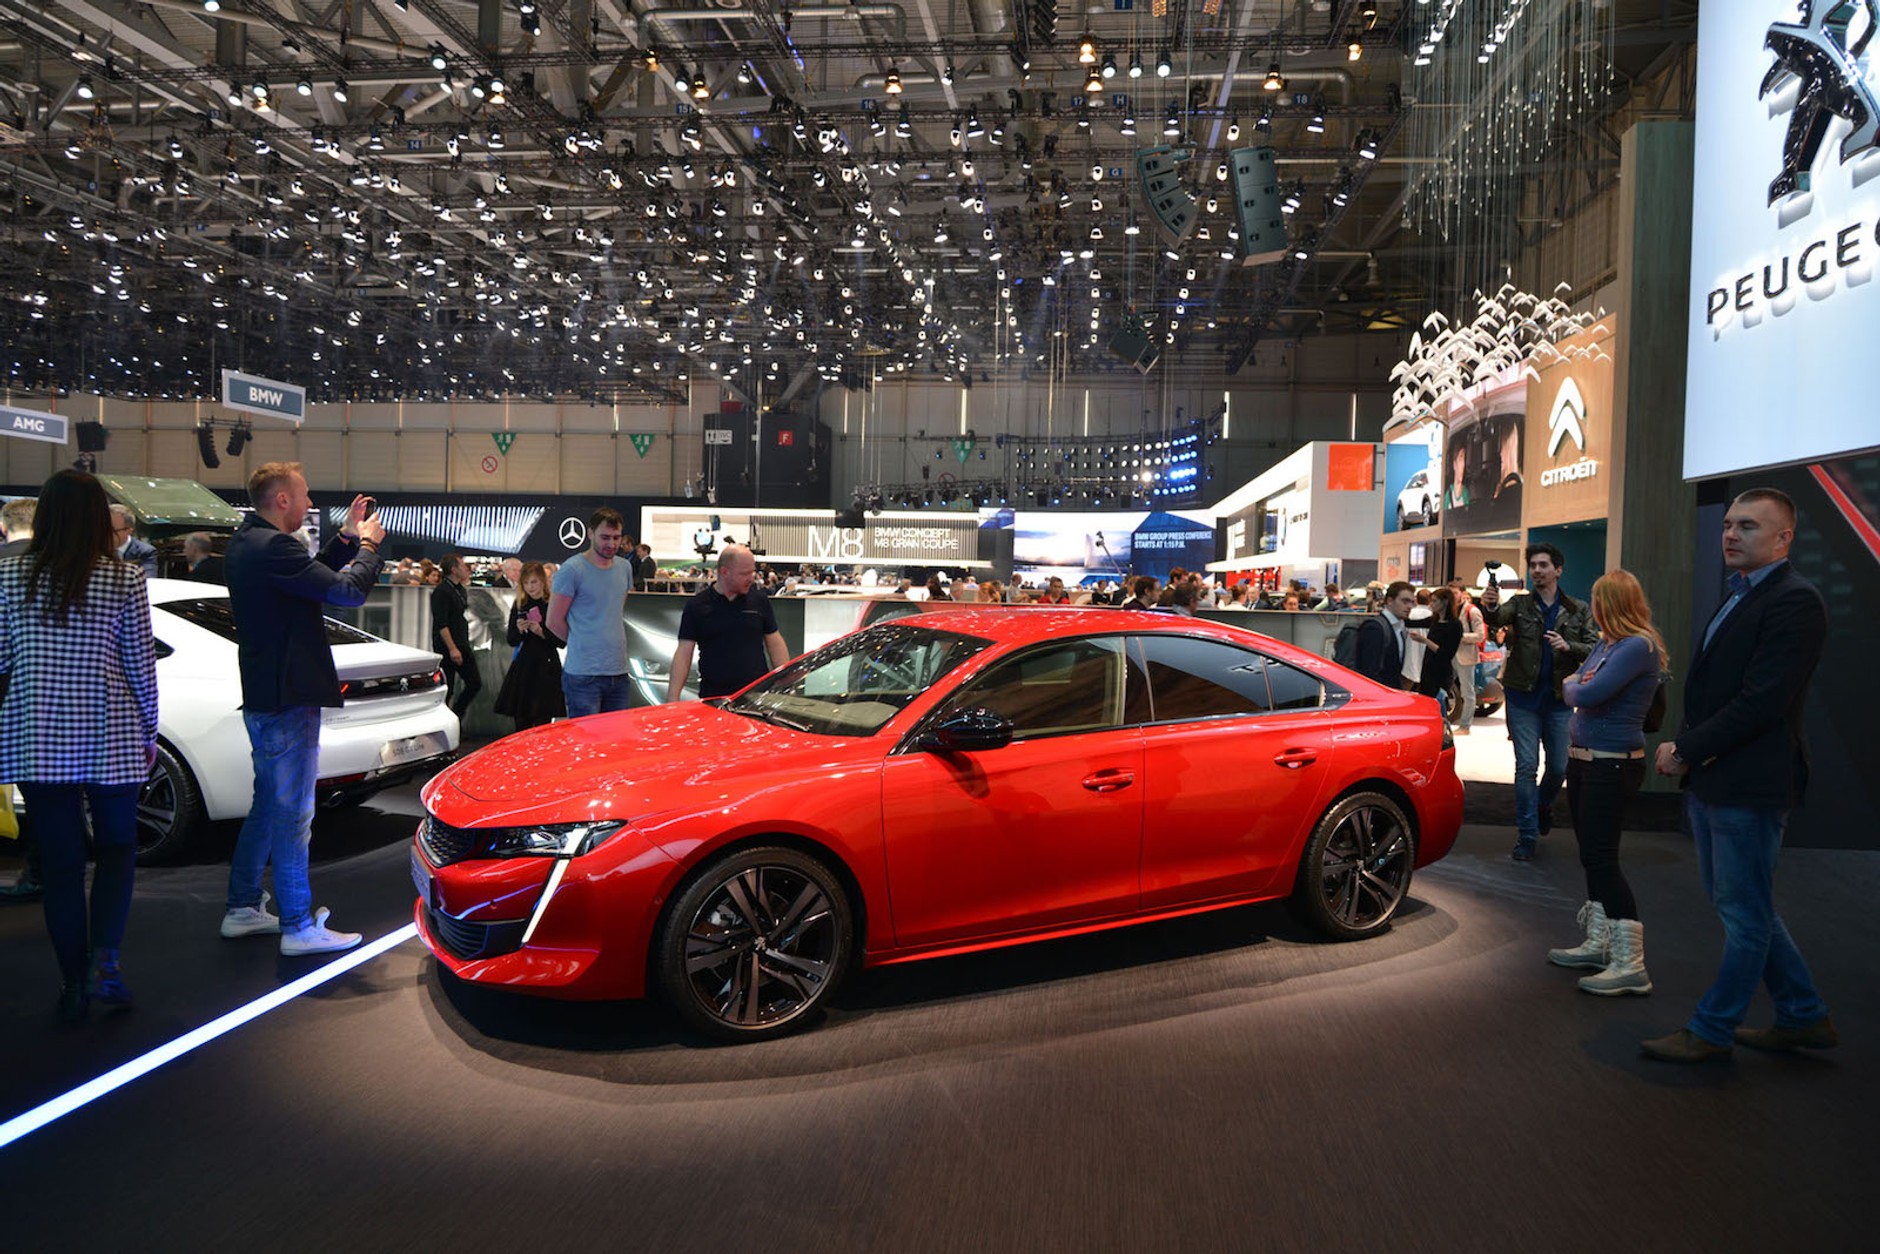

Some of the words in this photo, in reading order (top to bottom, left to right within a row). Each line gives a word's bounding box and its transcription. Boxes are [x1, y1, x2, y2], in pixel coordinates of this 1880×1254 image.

[1074, 97, 1083, 105] 17
[1297, 95, 1308, 104] 18
[410, 141, 420, 149] 14
[1706, 217, 1880, 325] PEUGE
[249, 386, 283, 407] BMW
[13, 416, 45, 432] AMG
[875, 527, 898, 538] BMW
[901, 528, 950, 538] CONCEPT
[808, 525, 864, 558] M8
[891, 538, 919, 549] GRAN
[922, 539, 959, 550] COUPE
